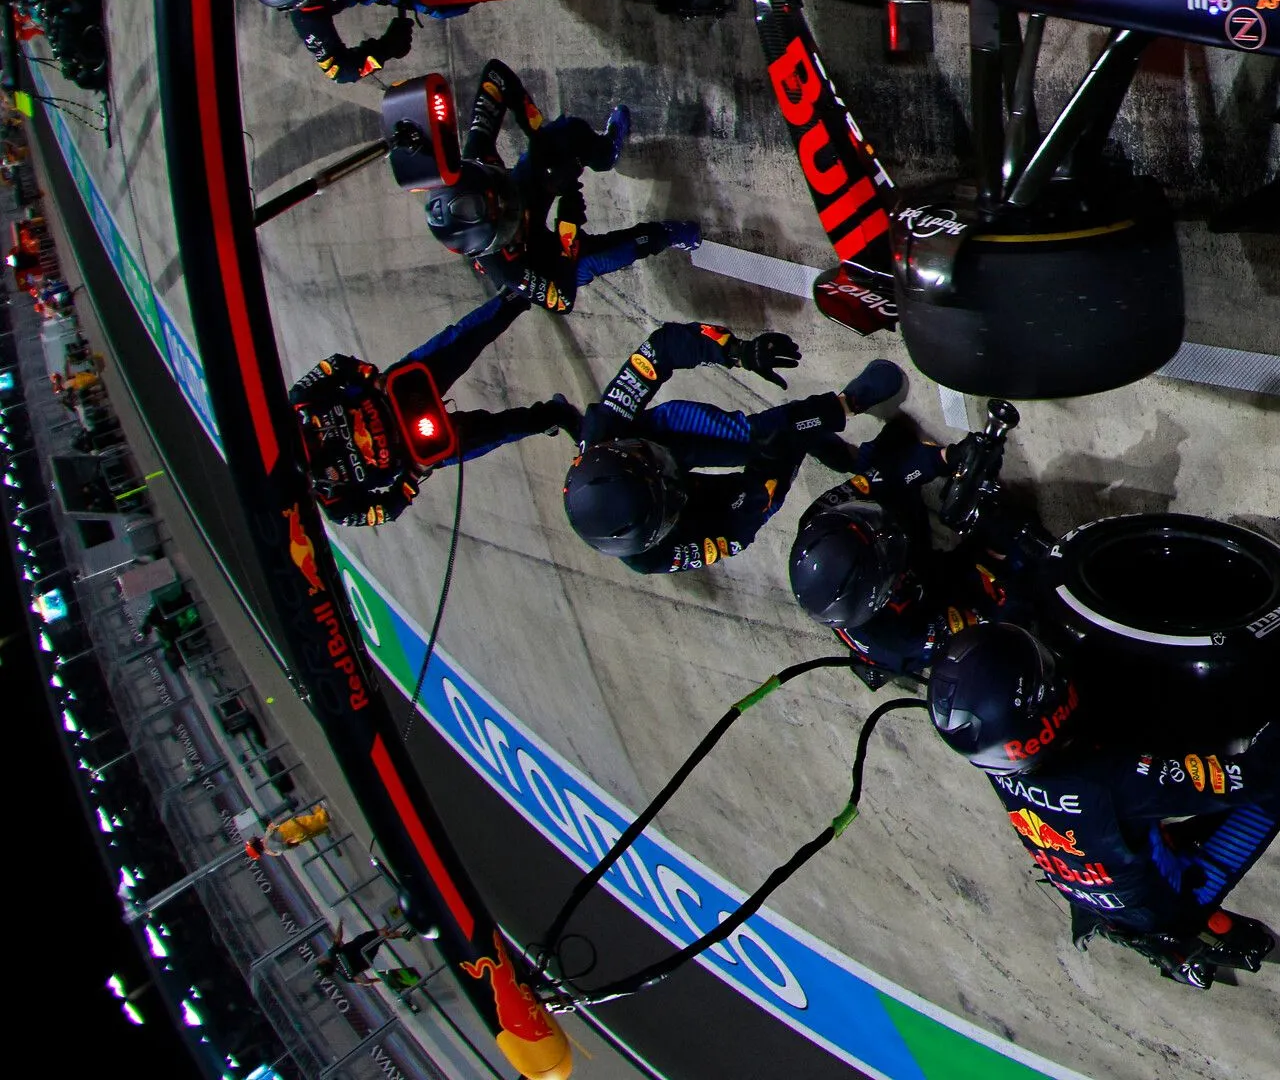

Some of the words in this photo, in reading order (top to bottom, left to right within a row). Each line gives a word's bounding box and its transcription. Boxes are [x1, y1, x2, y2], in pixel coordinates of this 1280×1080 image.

[767, 35, 892, 261] Bull
[817, 280, 899, 317] Claro
[607, 386, 638, 411] ROKT
[334, 403, 366, 482] ORACLE
[669, 545, 684, 572] Mobil
[1050, 544, 1062, 558] P
[996, 775, 1082, 814] RACLE
[1227, 764, 1244, 792] VIS
[442, 677, 808, 1009] aramco
